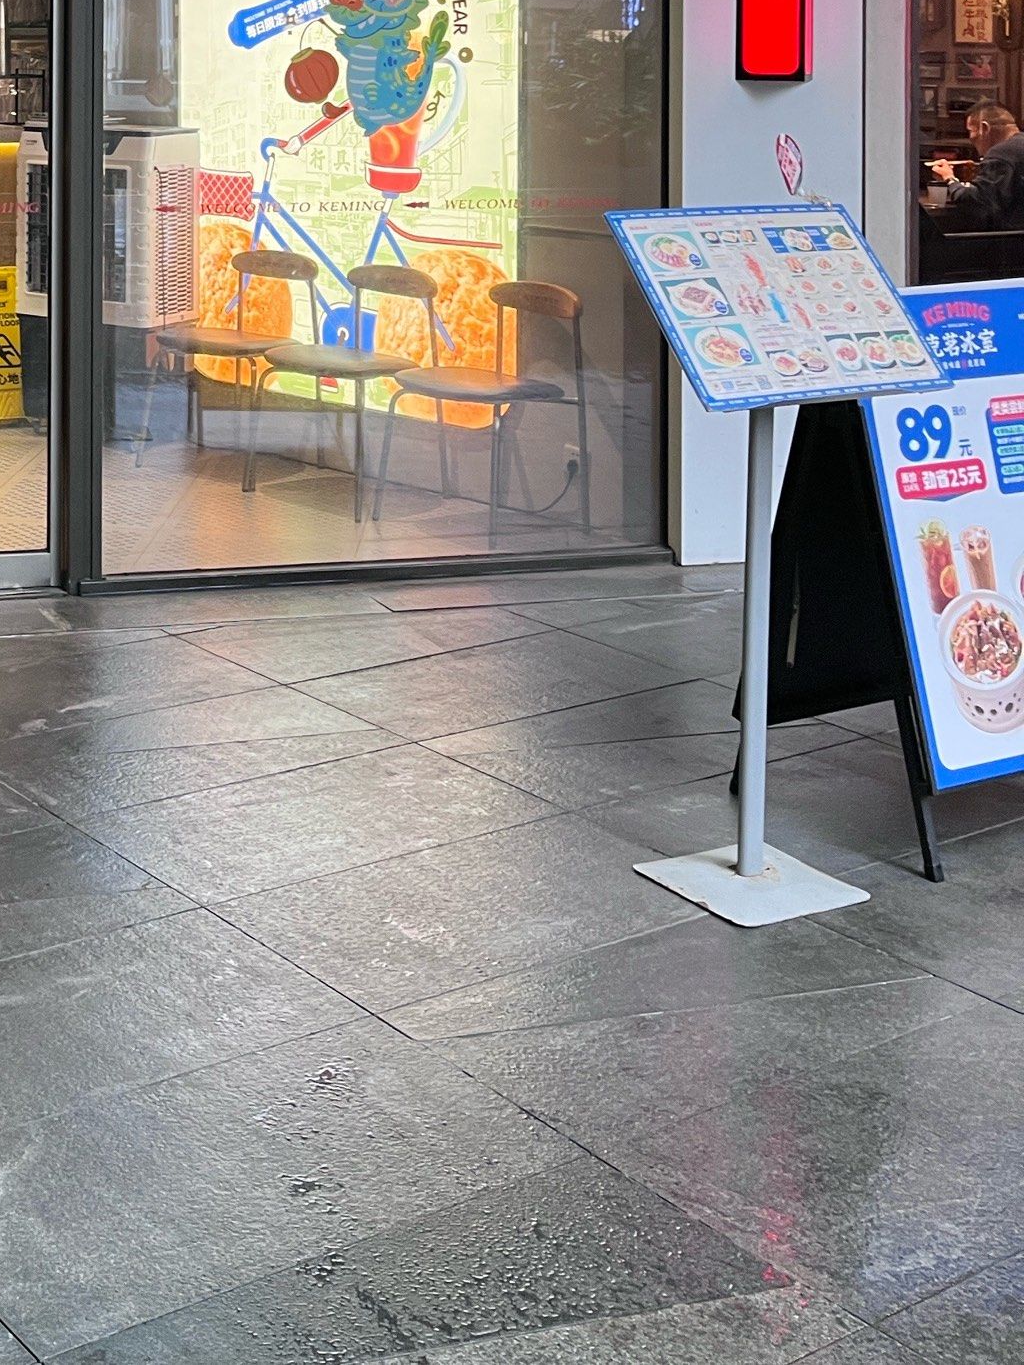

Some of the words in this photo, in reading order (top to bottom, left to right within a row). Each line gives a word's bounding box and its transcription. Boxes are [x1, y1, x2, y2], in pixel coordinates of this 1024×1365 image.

[200, 201, 280, 214] WELCOME
[289, 201, 312, 213] TO
[318, 200, 387, 213] KEMING
[896, 404, 952, 462] 89
[958, 438, 973, 457] 元
